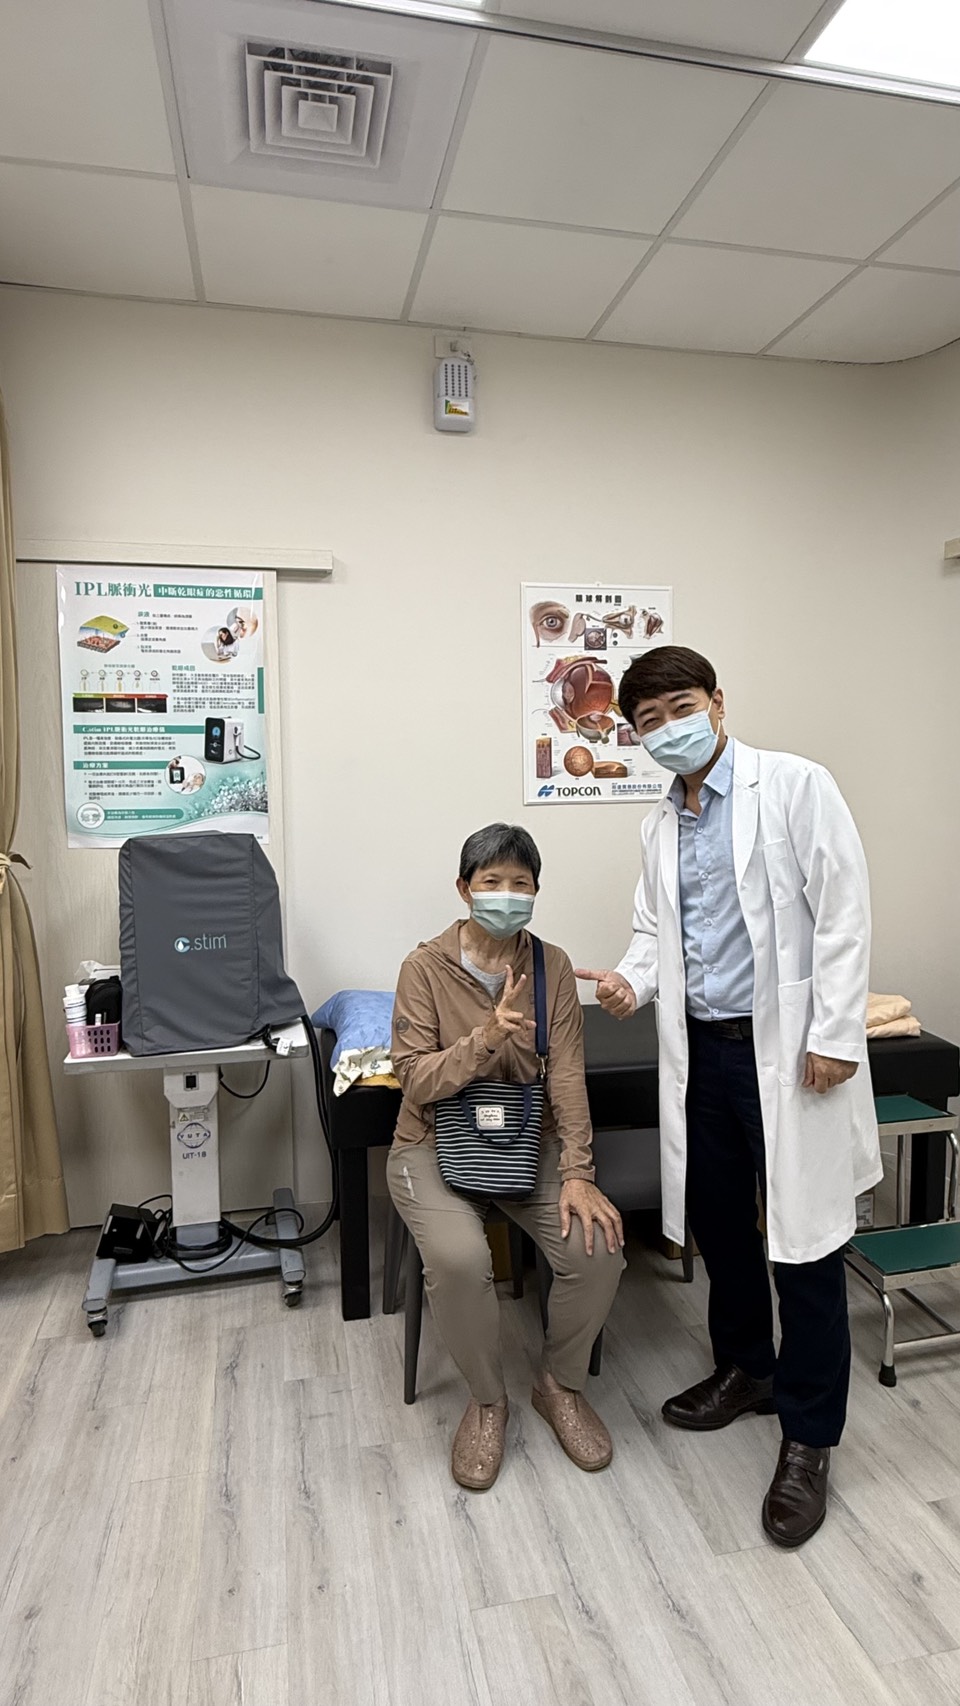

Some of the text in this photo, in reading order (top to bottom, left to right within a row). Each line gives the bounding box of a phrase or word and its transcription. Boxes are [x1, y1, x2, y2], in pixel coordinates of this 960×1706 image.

[74, 581, 152, 598] IPL脈衝光
[576, 594, 621, 603] 眼球解剖圖
[556, 786, 602, 797] TOPCON
